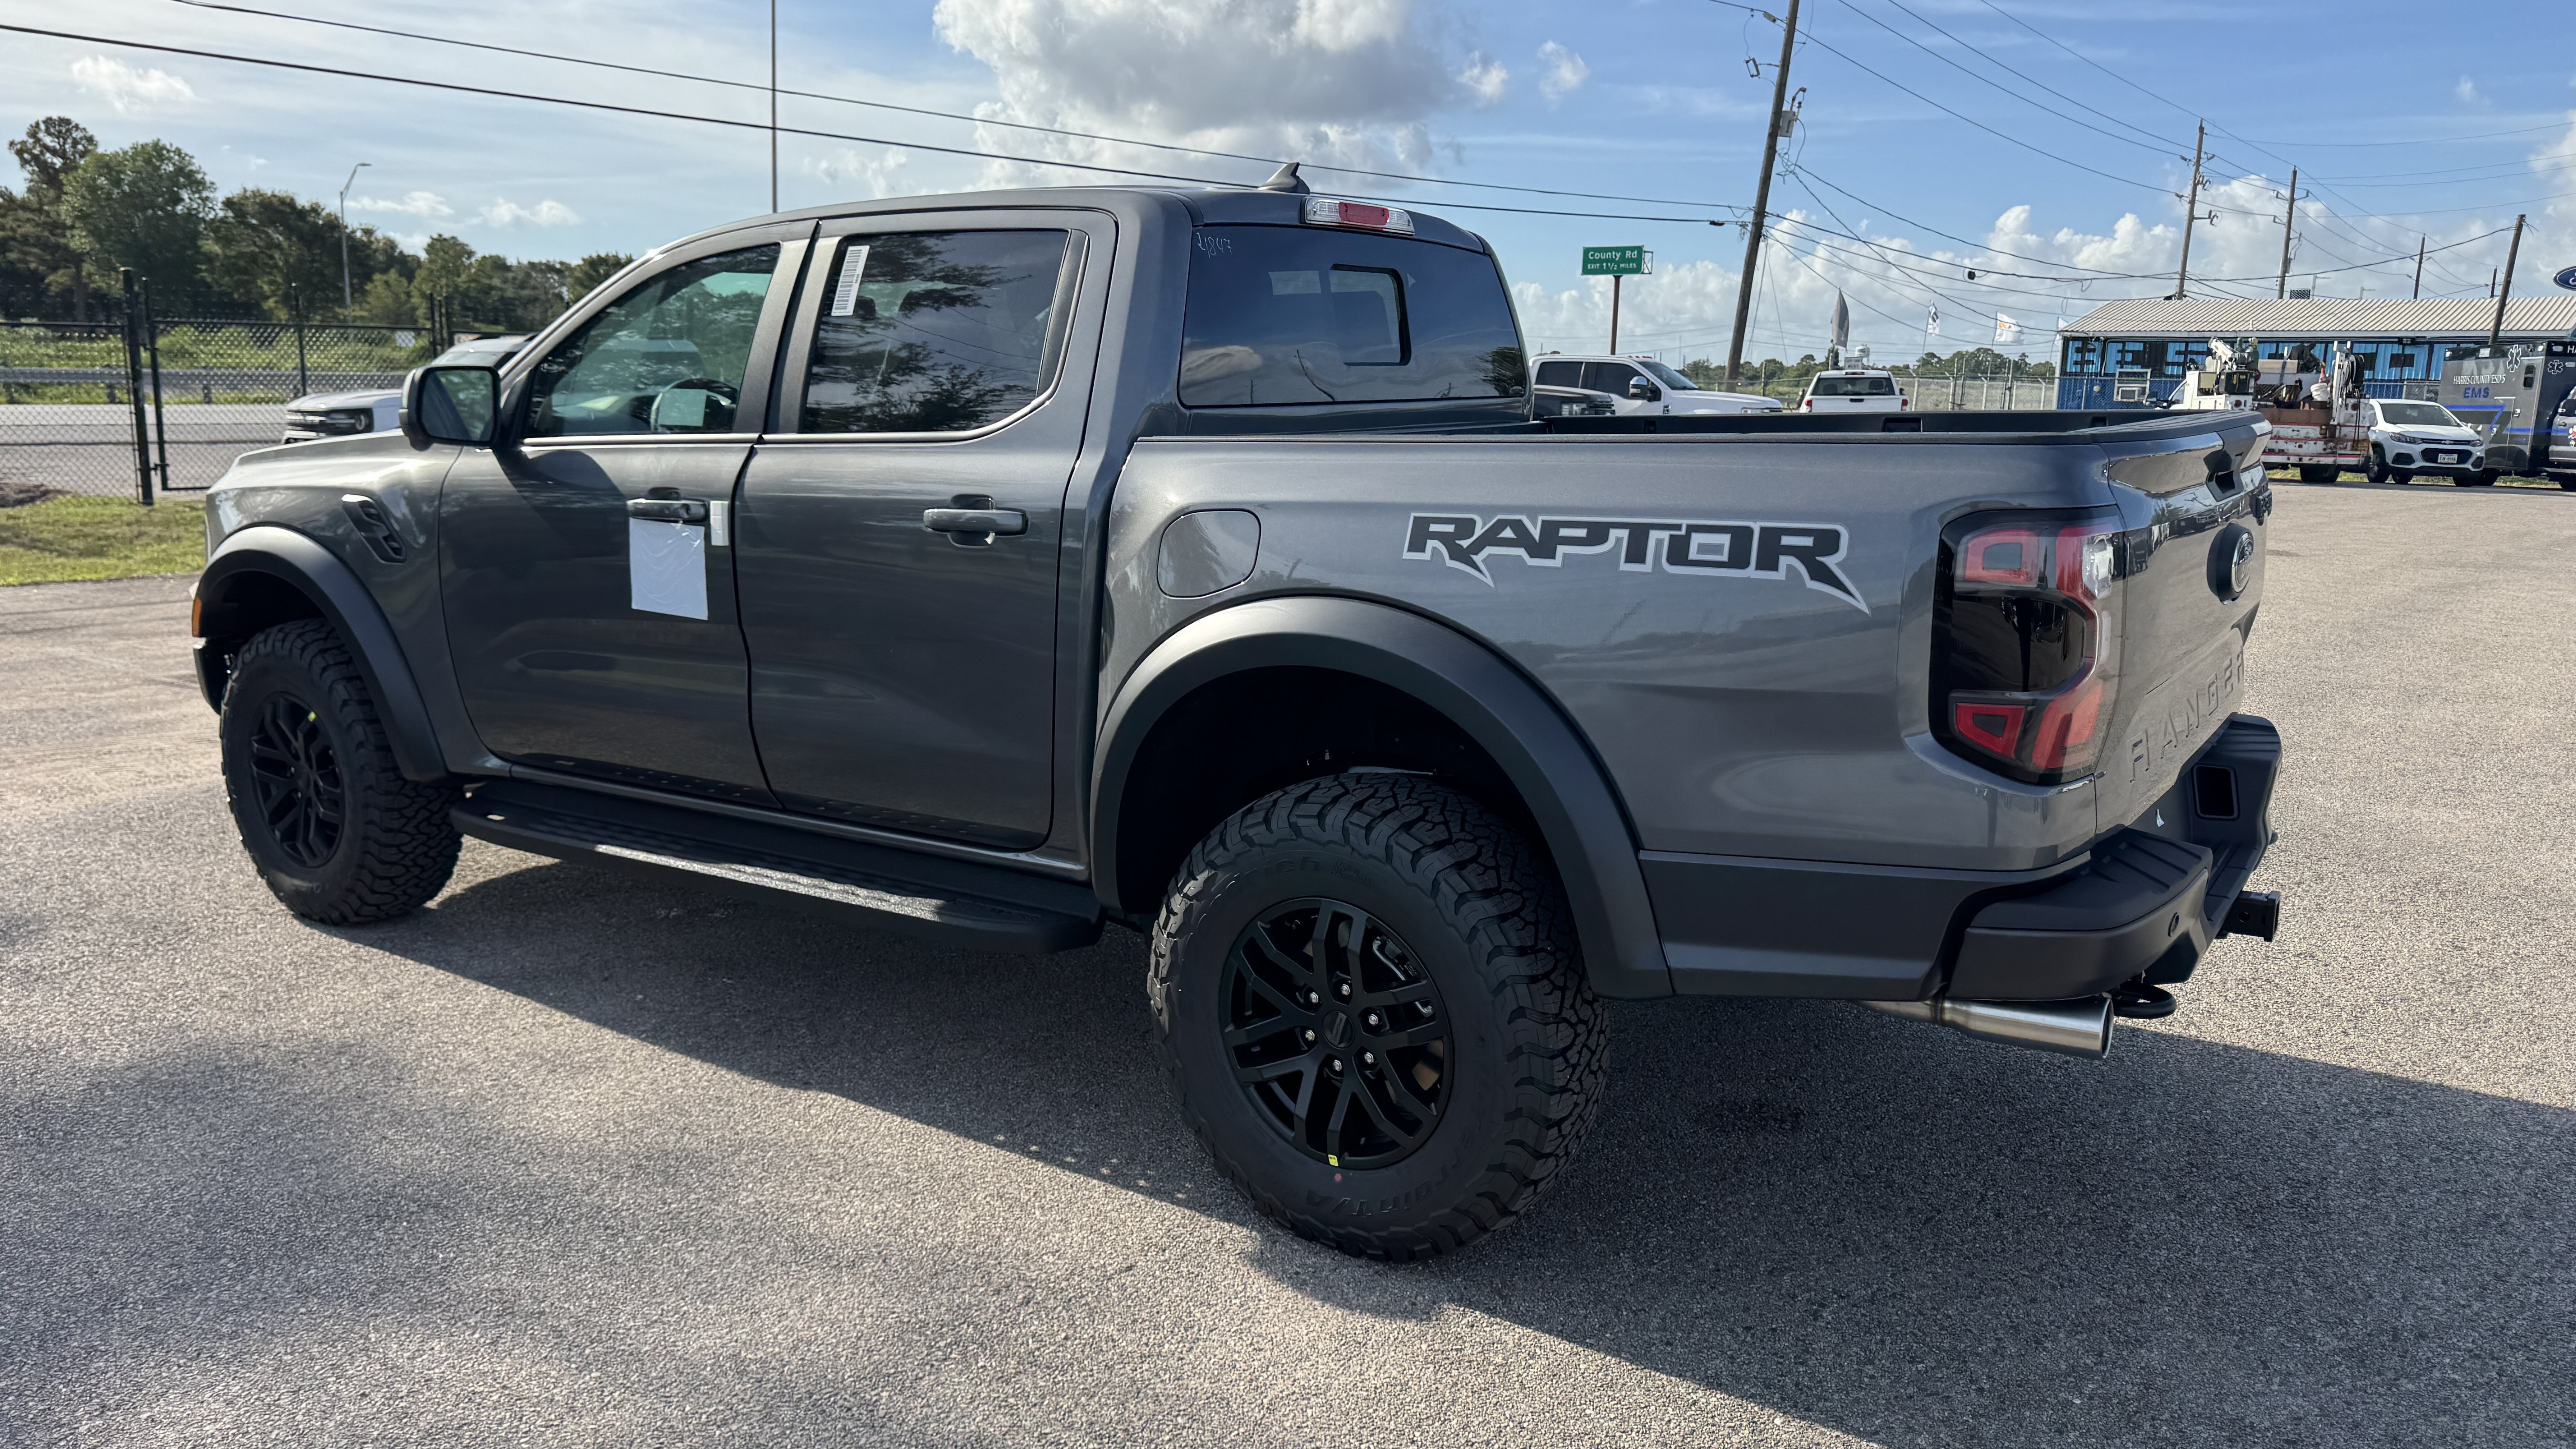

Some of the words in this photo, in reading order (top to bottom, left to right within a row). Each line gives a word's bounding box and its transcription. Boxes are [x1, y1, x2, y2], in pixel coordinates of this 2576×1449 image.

[1588, 251, 1621, 260] County
[1625, 250, 1638, 258] Rd
[2453, 375, 2470, 385] HARRIS
[2470, 375, 2490, 384] COUNTY
[2463, 387, 2490, 398] EMS
[1403, 512, 1871, 616] RAPTOR
